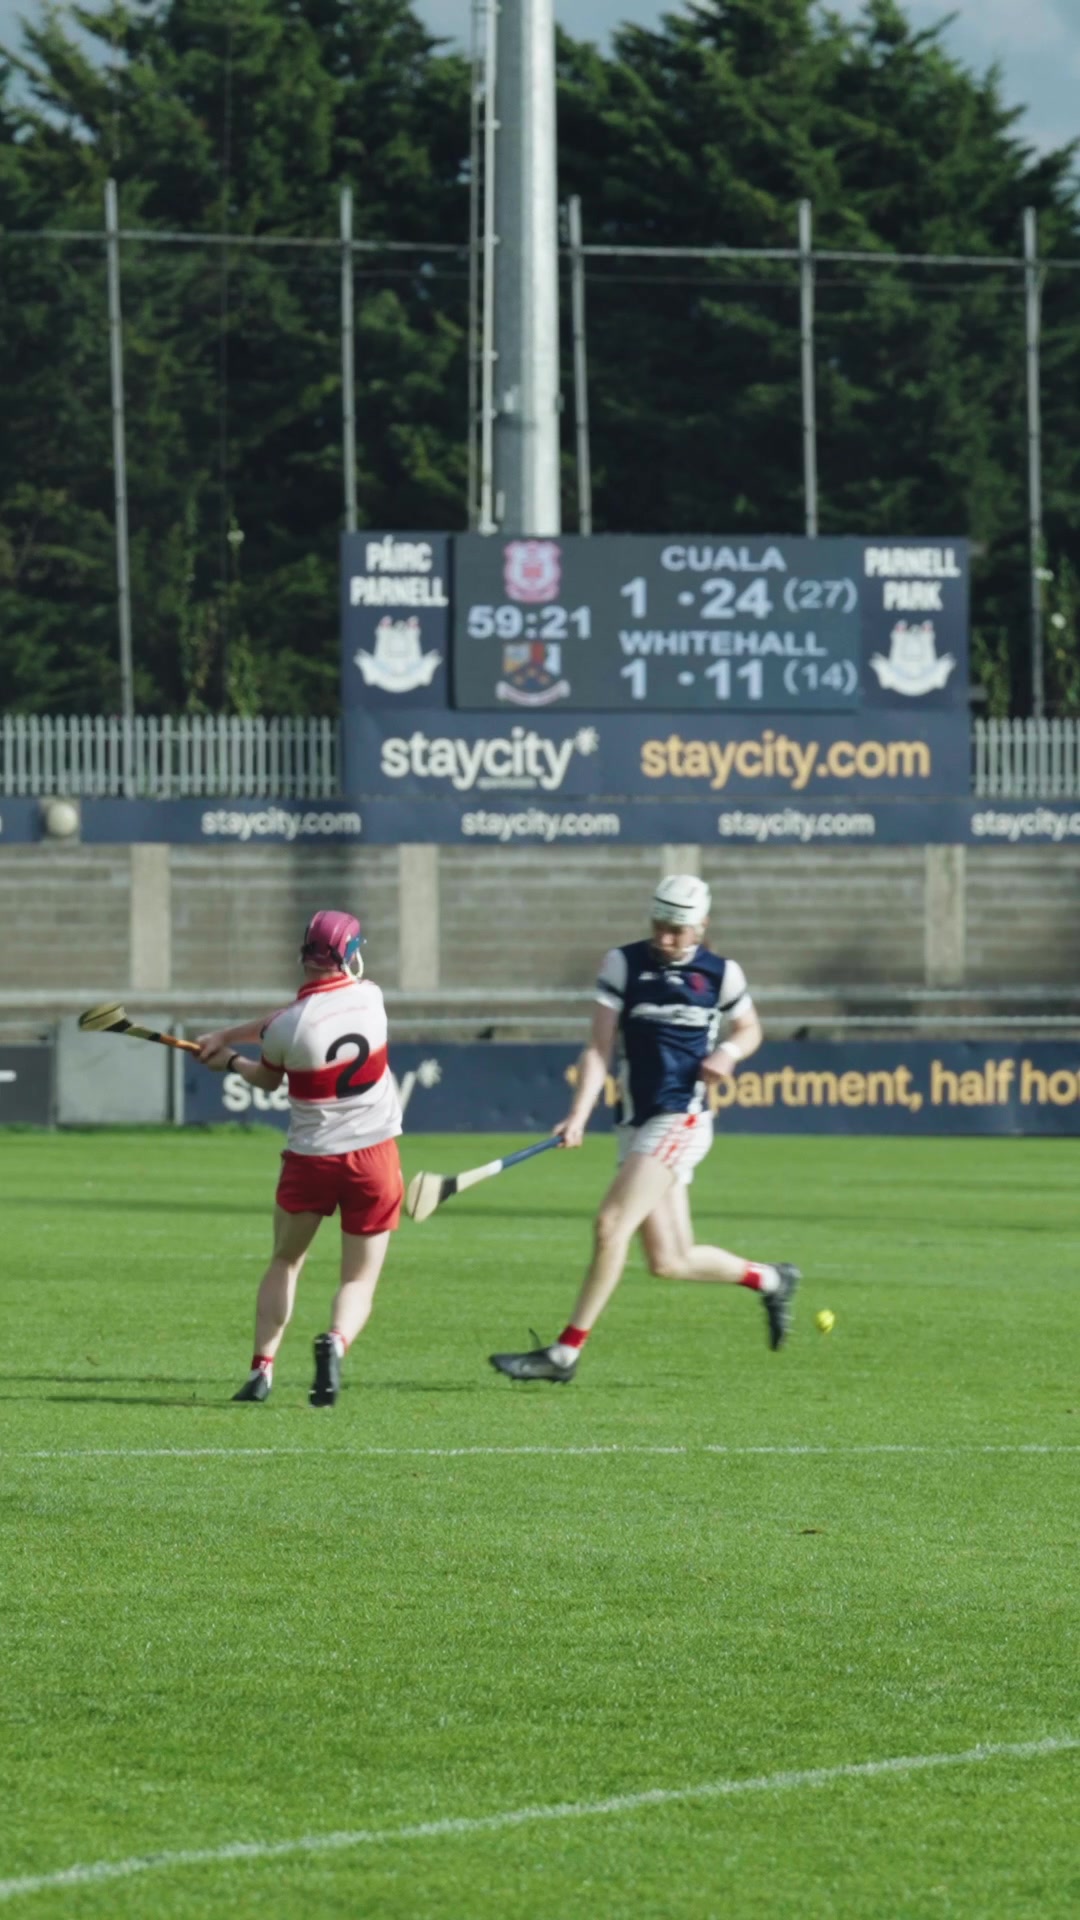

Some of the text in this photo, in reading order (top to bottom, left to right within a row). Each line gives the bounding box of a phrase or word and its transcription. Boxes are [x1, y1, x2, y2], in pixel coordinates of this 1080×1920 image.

[661, 545, 787, 572] CUALA
[864, 547, 961, 578] PARNELL
[350, 576, 449, 607] PARNELL
[620, 577, 647, 619] 1
[783, 577, 858, 614] (27)
[883, 580, 943, 611] PARK
[466, 604, 592, 640] 59:21
[618, 630, 828, 657] WHITEHALL
[620, 658, 647, 701] 1
[783, 659, 858, 695] (14)
[640, 729, 931, 790] staycity.com
[201, 806, 362, 841] staycity.com
[461, 807, 620, 842] staycity.com
[718, 807, 875, 842] staycity.com
[971, 807, 1080, 842] staycity.c
[325, 1032, 378, 1099] 2
[708, 1058, 1080, 1118] partment, half ho
